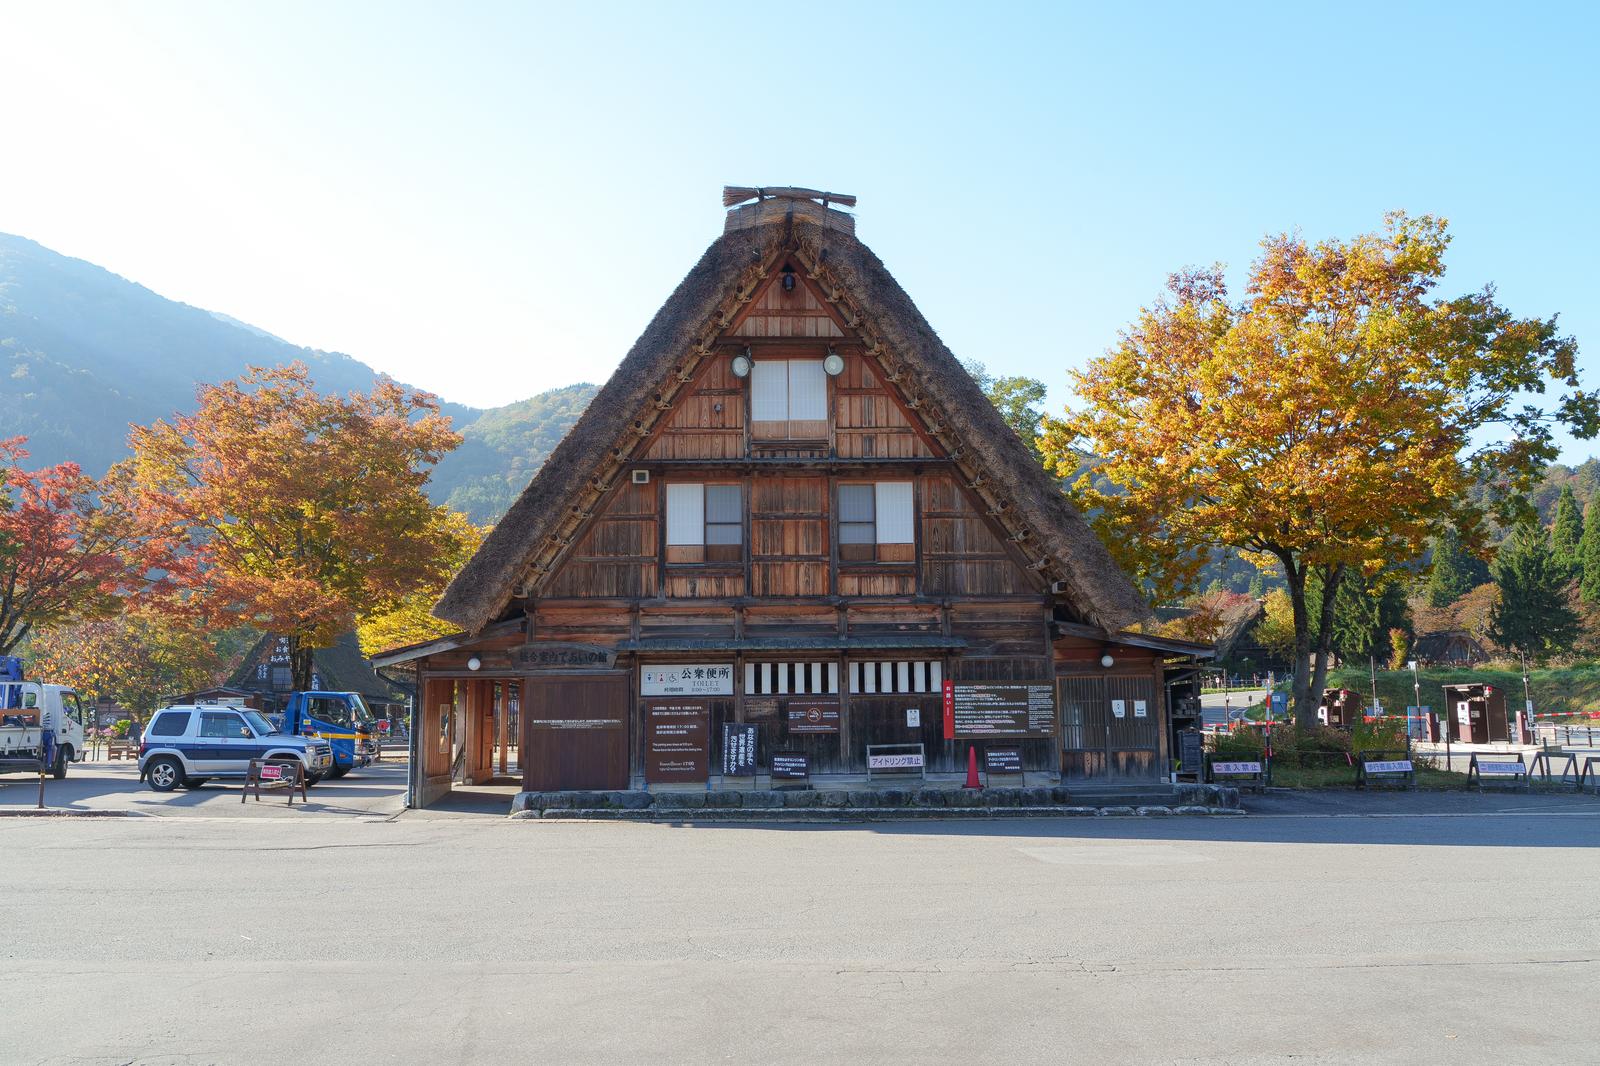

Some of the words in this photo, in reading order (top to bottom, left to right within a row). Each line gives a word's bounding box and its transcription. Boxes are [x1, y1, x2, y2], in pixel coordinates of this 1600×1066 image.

[681, 667, 730, 680] 公衆便所
[872, 757, 921, 767] アイドリング禁止
